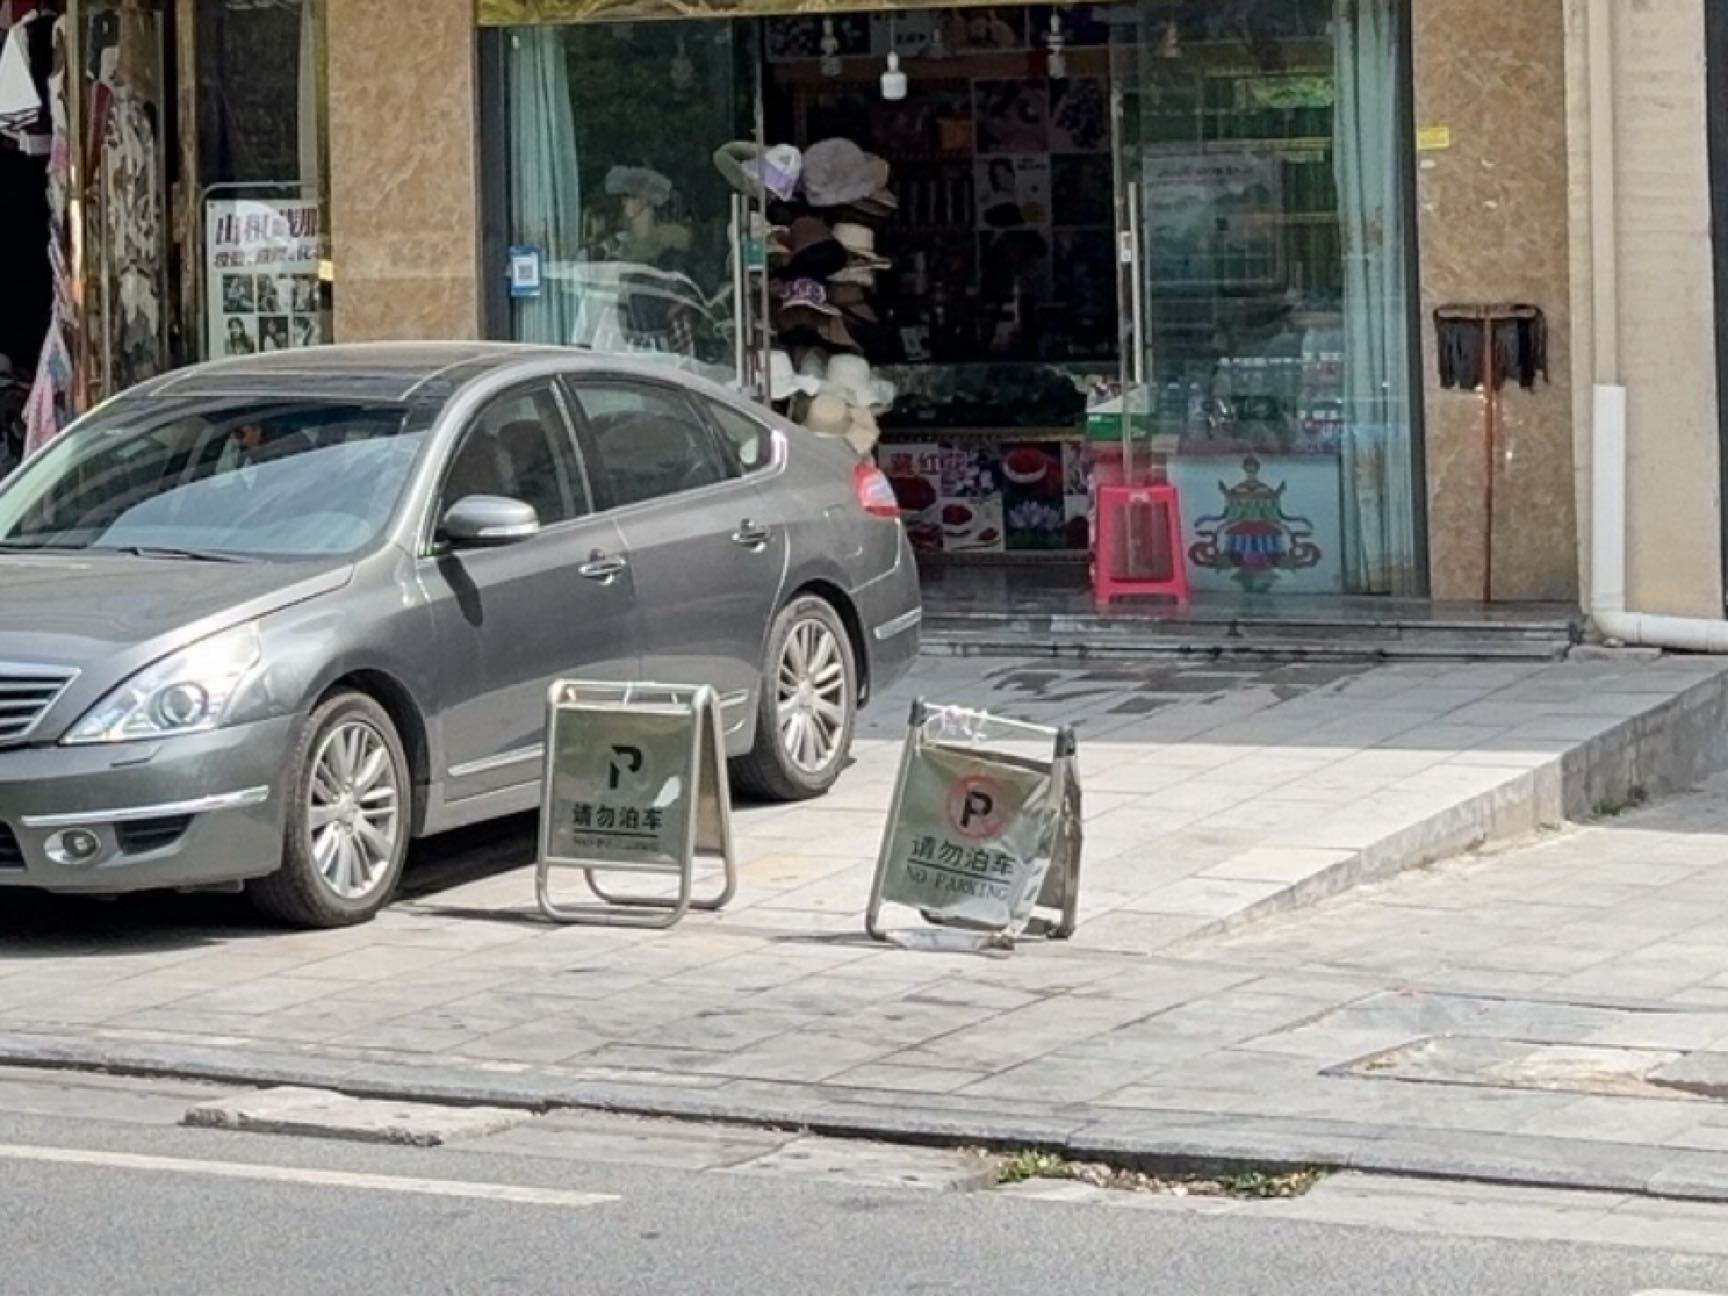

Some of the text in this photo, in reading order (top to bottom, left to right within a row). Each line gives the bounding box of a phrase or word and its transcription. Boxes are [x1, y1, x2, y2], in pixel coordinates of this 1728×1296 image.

[573, 803, 663, 831] 请勿泊车
[911, 836, 1016, 876] 请勿泊车
